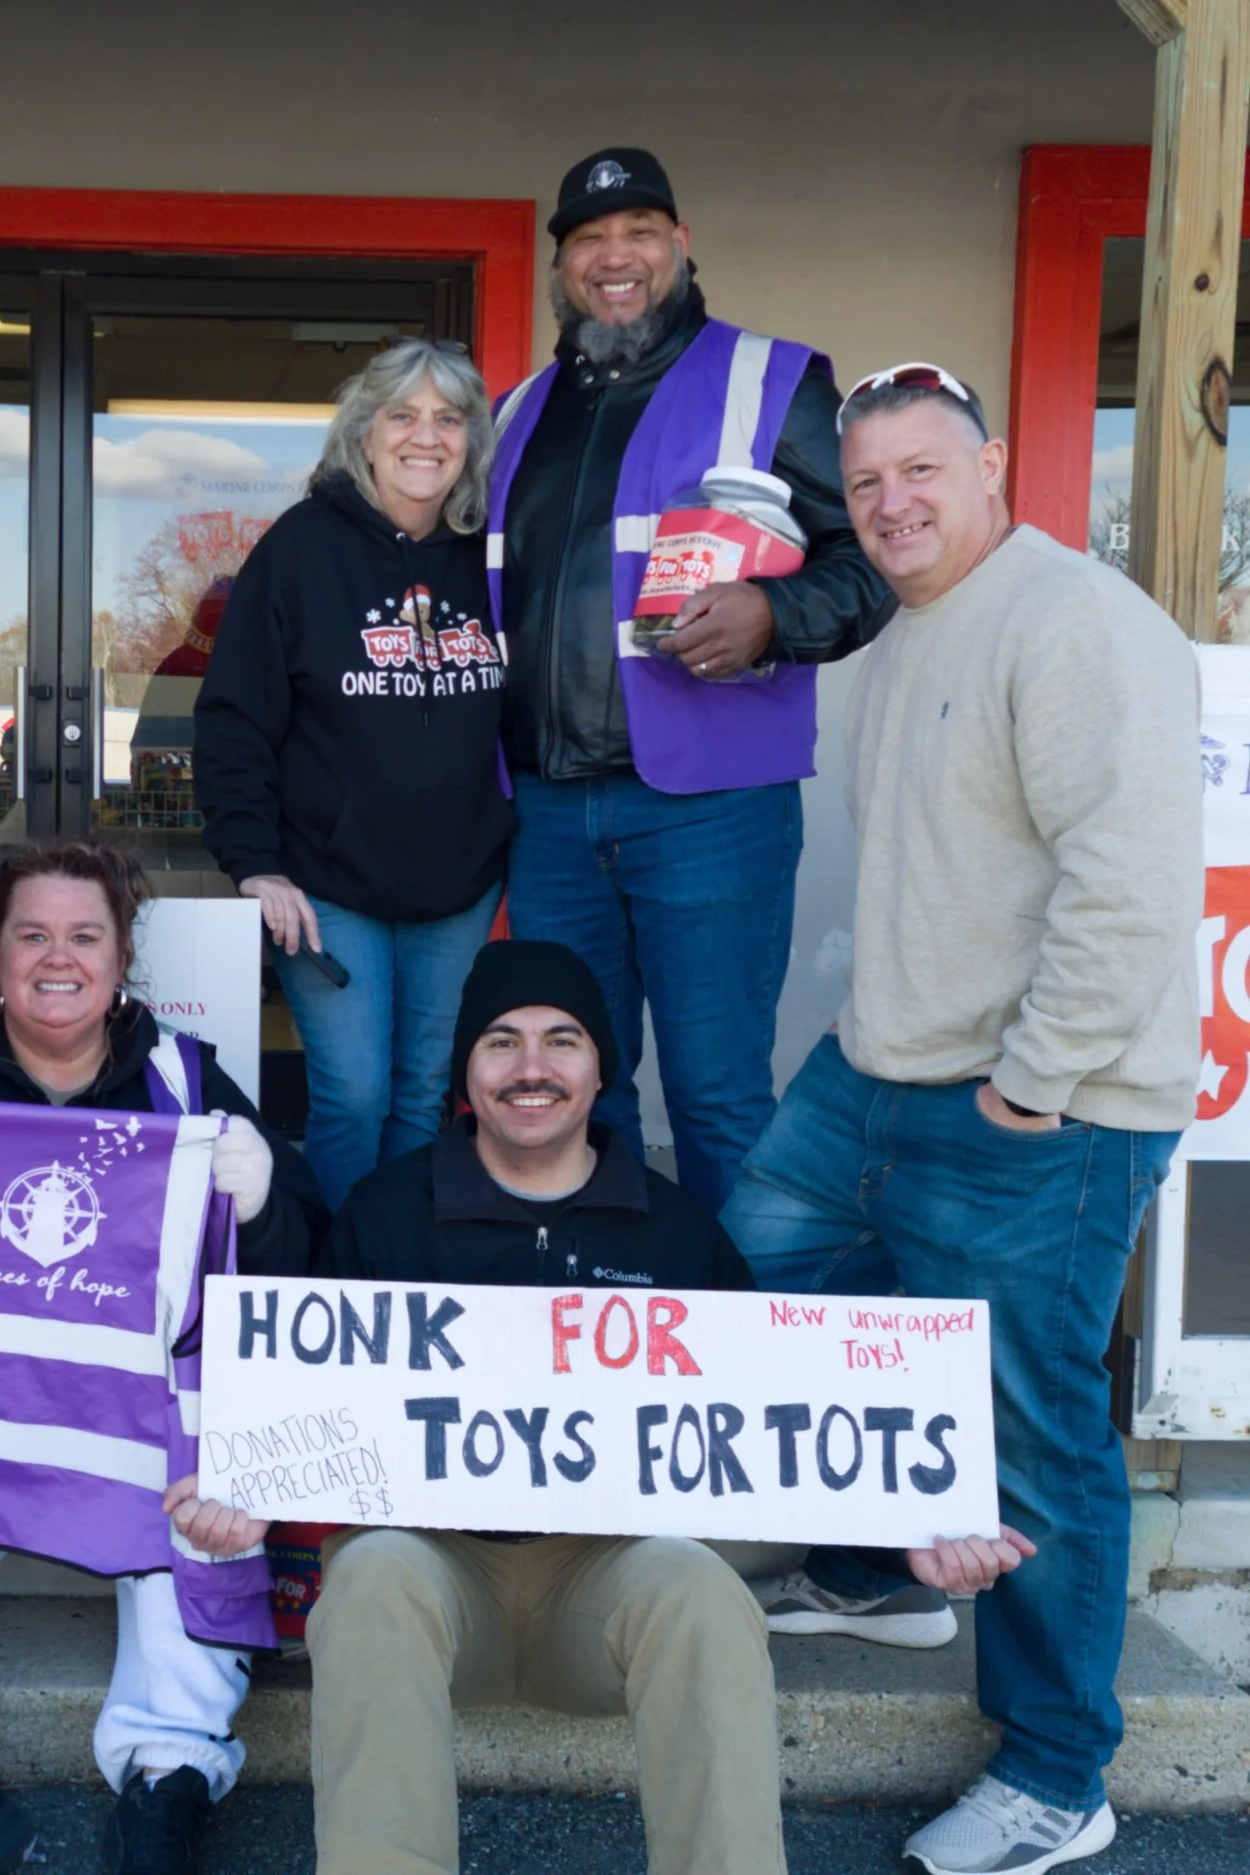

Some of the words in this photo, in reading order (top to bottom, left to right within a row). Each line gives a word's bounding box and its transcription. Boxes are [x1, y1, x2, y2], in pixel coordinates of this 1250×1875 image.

[201, 481, 250, 494] MARINE
[253, 481, 295, 494] CORPS
[660, 561, 678, 574] FOR
[682, 559, 710, 578] TOTS
[371, 634, 410, 652] TOYS
[447, 634, 487, 654] TOTS
[341, 671, 389, 696] ONE
[392, 673, 426, 697] TOY
[433, 673, 457, 697] AT
[461, 669, 476, 693] A
[160, 1001, 206, 1016] ONLY
[37, 1266, 66, 1302] of
[70, 1268, 131, 1307] hope
[604, 1268, 653, 1285] Columbia
[238, 1289, 466, 1371] HONK
[551, 1293, 702, 1376] FOR
[769, 1299, 825, 1327] New
[848, 1307, 975, 1342] unwrapped
[205, 1407, 359, 1475] DONATIONS
[404, 1396, 596, 1488] TOYS
[636, 1402, 755, 1498] FOR
[763, 1402, 957, 1496] TOTS
[231, 1437, 389, 1511] APPRECIATED!
[275, 1577, 307, 1600] FOR
